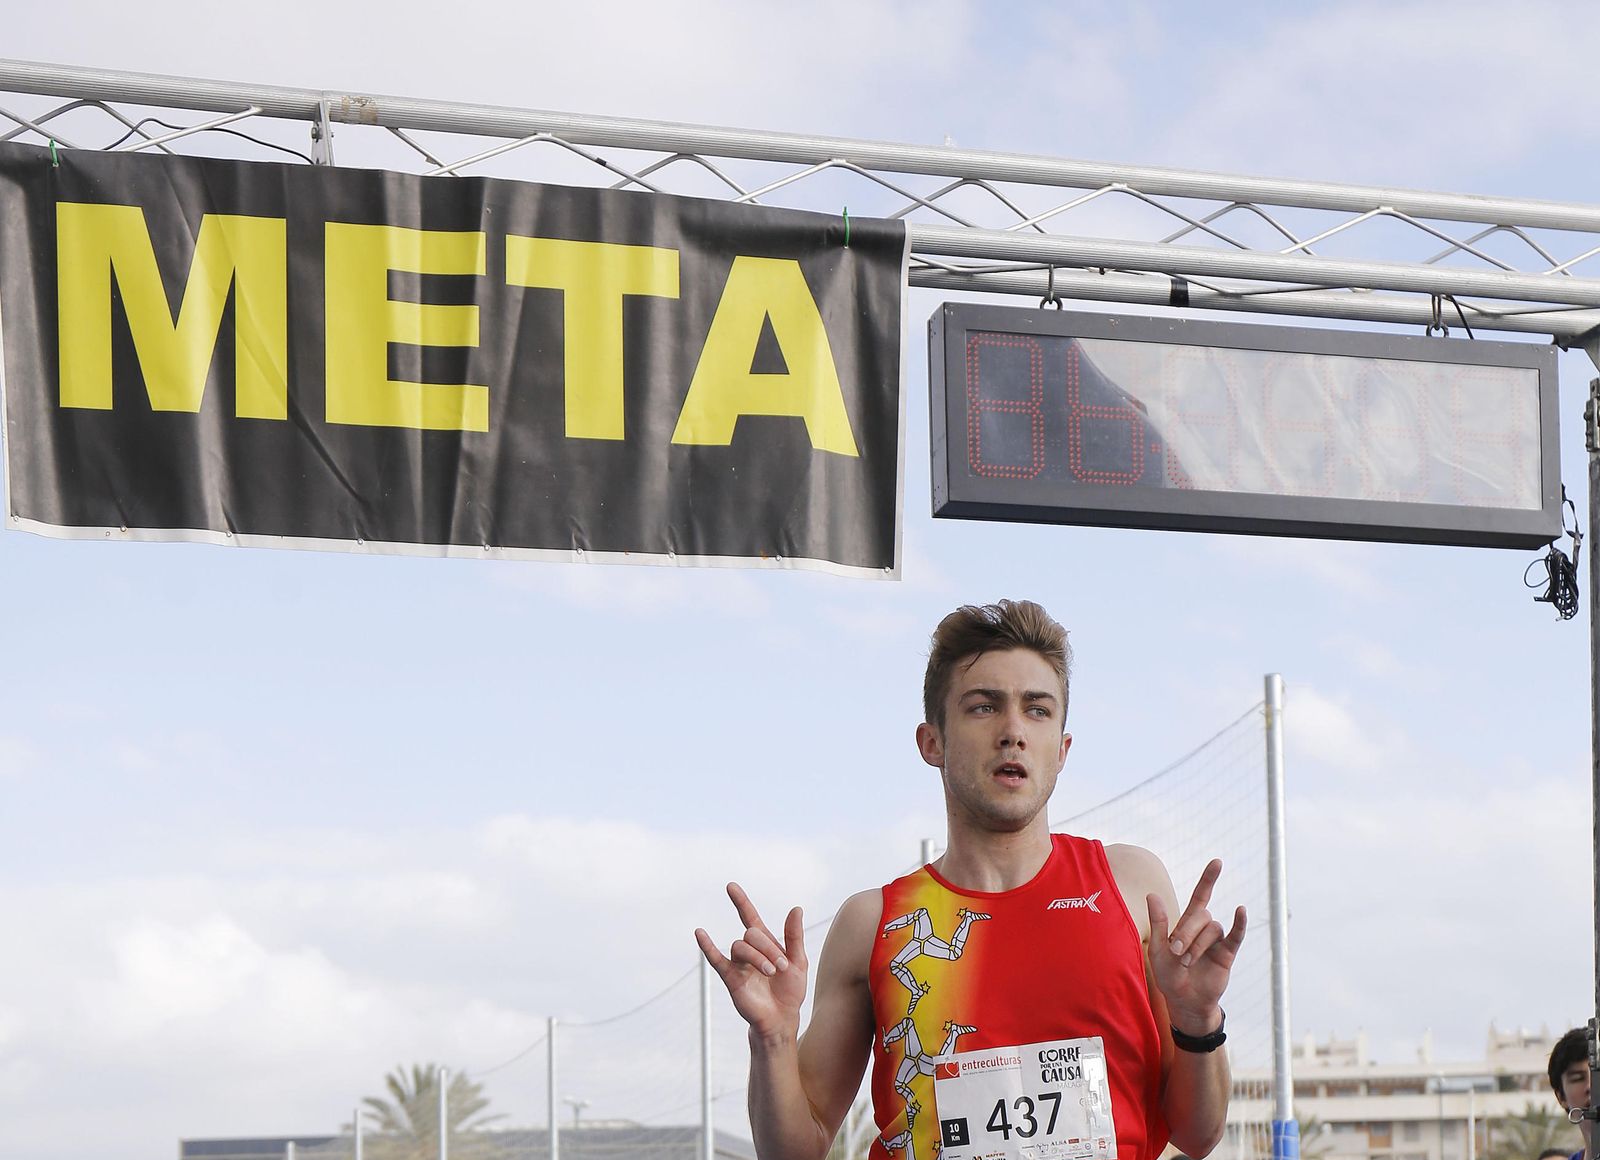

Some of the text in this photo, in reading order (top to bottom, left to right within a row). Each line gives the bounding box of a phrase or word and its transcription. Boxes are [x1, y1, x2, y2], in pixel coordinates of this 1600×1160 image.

[56, 201, 860, 458] META
[961, 1056, 1022, 1071] entreculturas
[1041, 1065, 1082, 1083] CAUSA
[985, 1091, 1062, 1141] 437
[949, 1123, 960, 1133] 10
